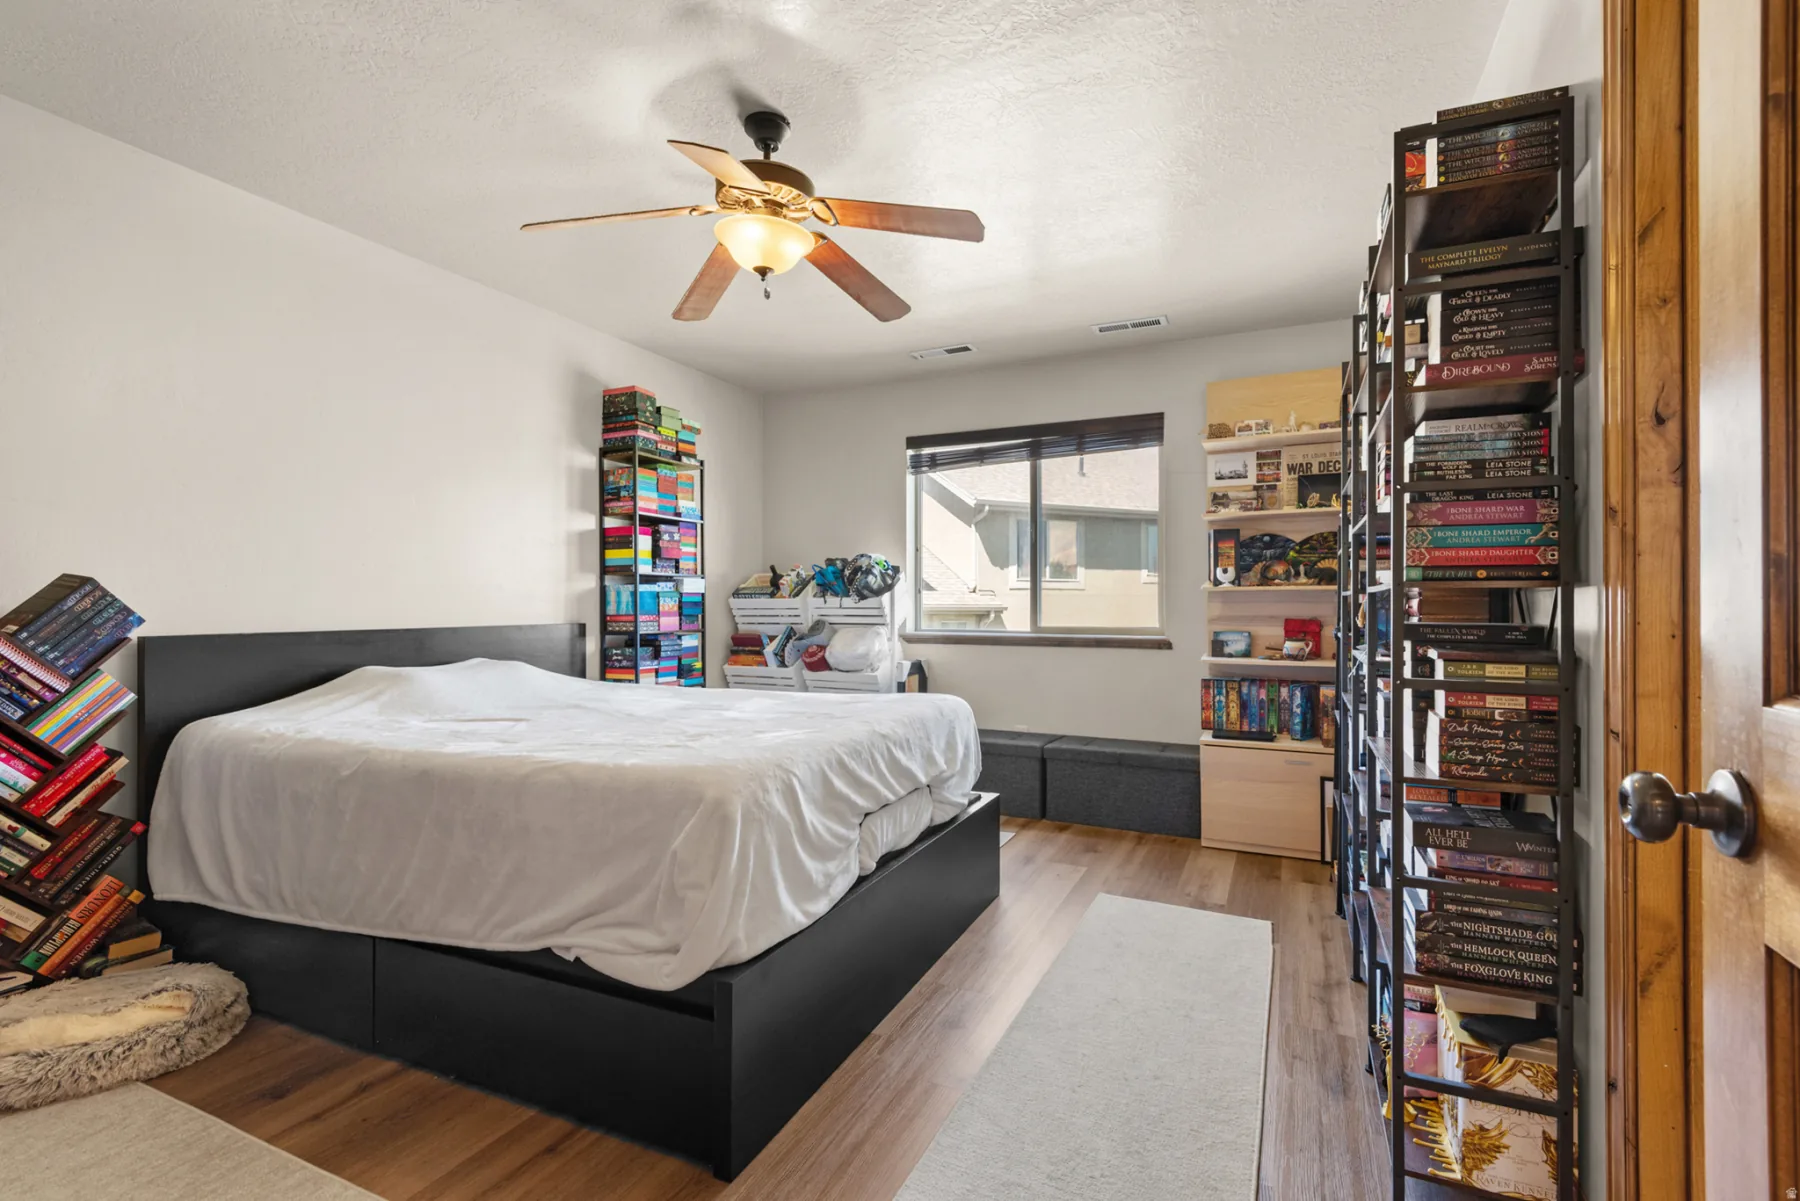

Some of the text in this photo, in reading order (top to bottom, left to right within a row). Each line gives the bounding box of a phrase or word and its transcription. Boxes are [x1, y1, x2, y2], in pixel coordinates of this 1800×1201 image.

[1447, 136, 1463, 144] THE
[1447, 160, 1463, 168] THE
[1420, 245, 1508, 264] THE COMPLETE EVELYN
[1428, 253, 1503, 270] MAYNARD TRILOGY
[1482, 292, 1511, 303] DEADLY
[1478, 312, 1505, 322] HEAVY
[1482, 330, 1507, 339] EMPTY
[1478, 349, 1505, 358] LOVELY
[1442, 363, 1510, 380] DIREBOUND
[1455, 423, 1487, 432] REALM
[1287, 461, 1313, 475] WAR
[1485, 460, 1532, 469] LEIA STONE
[1505, 469, 1532, 477] STONE
[1506, 491, 1533, 499] STONE
[1449, 512, 1524, 521] ANDREA STEWART
[1450, 506, 1473, 514] BONE
[1493, 528, 1532, 536] EMPEROR
[1446, 536, 1481, 544] ANDREA
[72, 588, 102, 613] SCARRED
[91, 603, 118, 626] TWISTED
[1461, 628, 1486, 636] WORLD
[62, 760, 86, 780] MALLERY
[1425, 828, 1472, 841] ALL HE'LL
[1429, 837, 1469, 849] EVER BE
[101, 844, 122, 865] QUEEN
[73, 867, 99, 892] THIEVES
[74, 877, 121, 924] LEON URIS
[101, 900, 130, 928] HANNAH
[1463, 923, 1534, 939] NIGHTSHADE
[1463, 930, 1547, 947] HANNAH WHITTEN
[67, 936, 99, 967] WOMEN
[1450, 942, 1557, 966] THE HEMLOCK QUEEN
[1461, 951, 1544, 969] HANNAH WHITTEN
[1464, 962, 1521, 980] FOXGLOVE
[1523, 972, 1553, 985] KING
[1476, 1174, 1511, 1189] RAVEN
